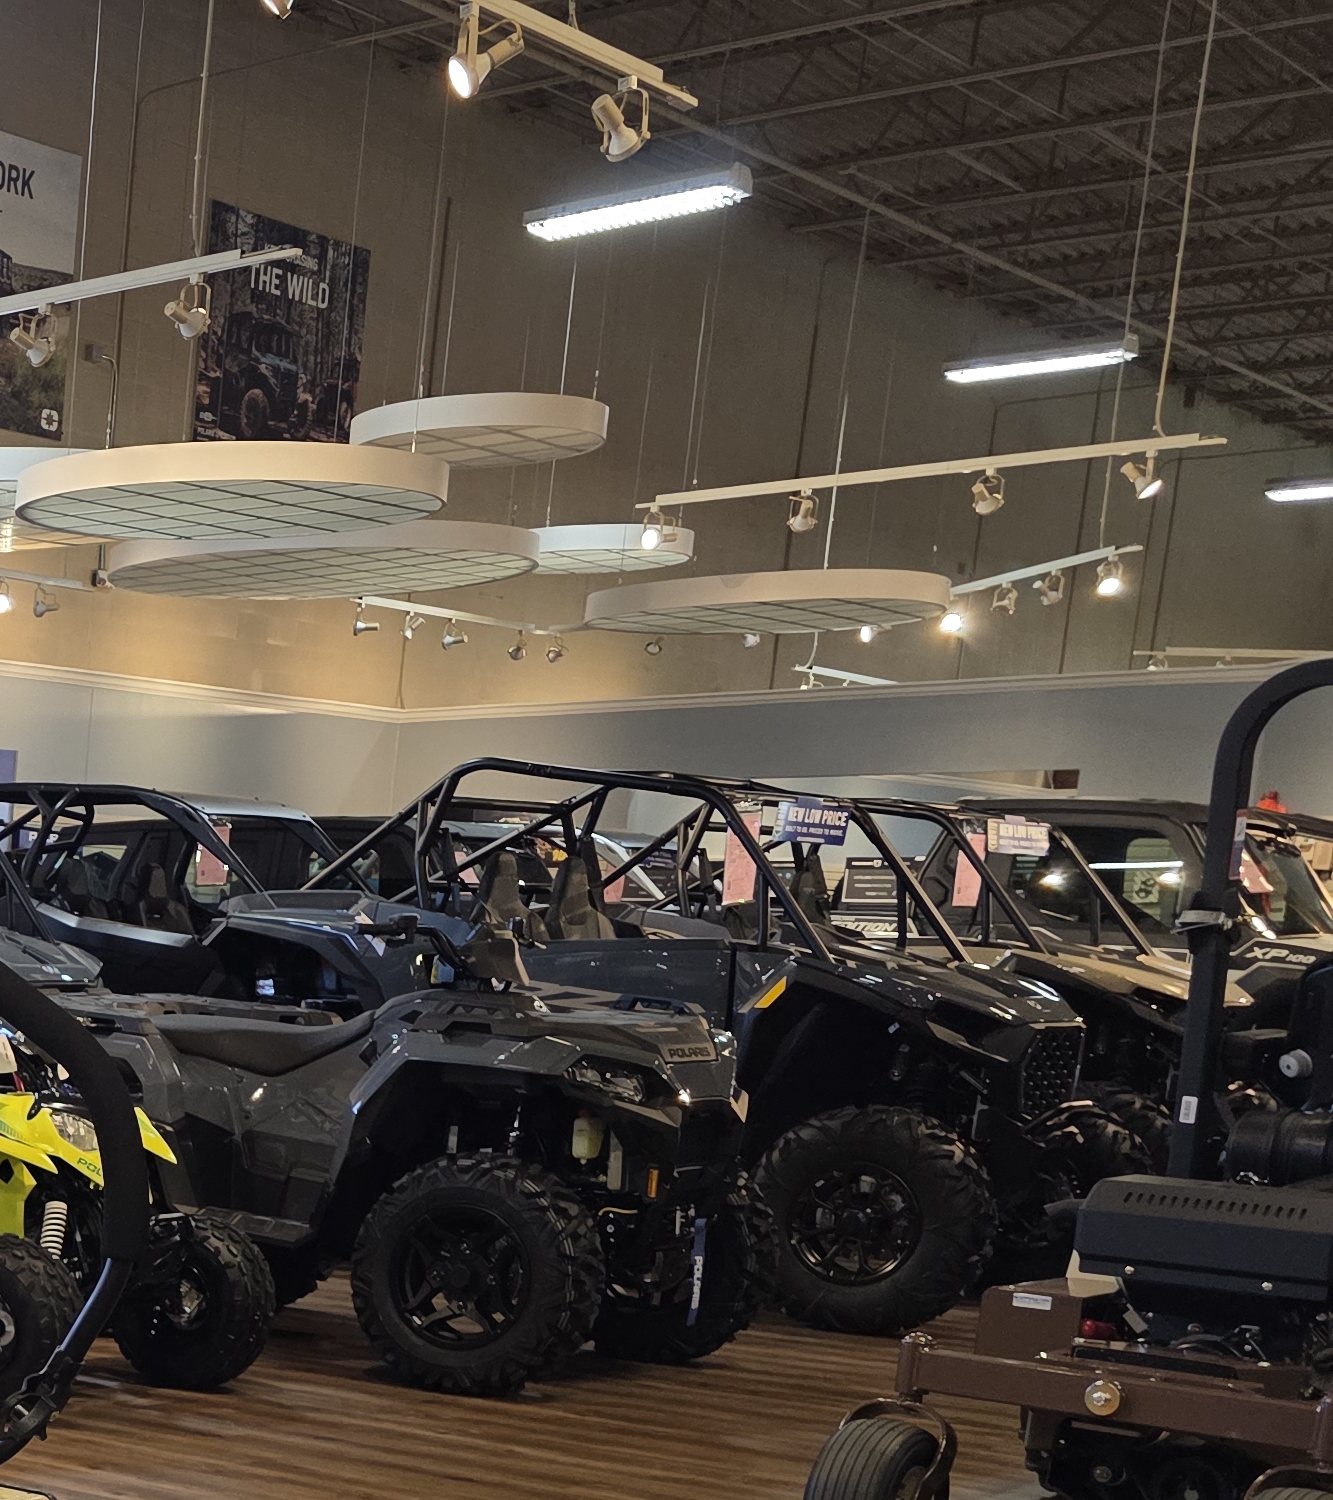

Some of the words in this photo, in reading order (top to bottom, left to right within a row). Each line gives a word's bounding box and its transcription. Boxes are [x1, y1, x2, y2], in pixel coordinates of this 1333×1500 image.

[251, 263, 283, 296] THE
[287, 272, 329, 309] WILD
[804, 808, 822, 824] LOW
[822, 810, 849, 826] PRICE
[1244, 946, 1289, 960] XP
[667, 1046, 712, 1059] POLARIS
[77, 1157, 102, 1177] POL
[691, 1255, 703, 1309] POLARIS
